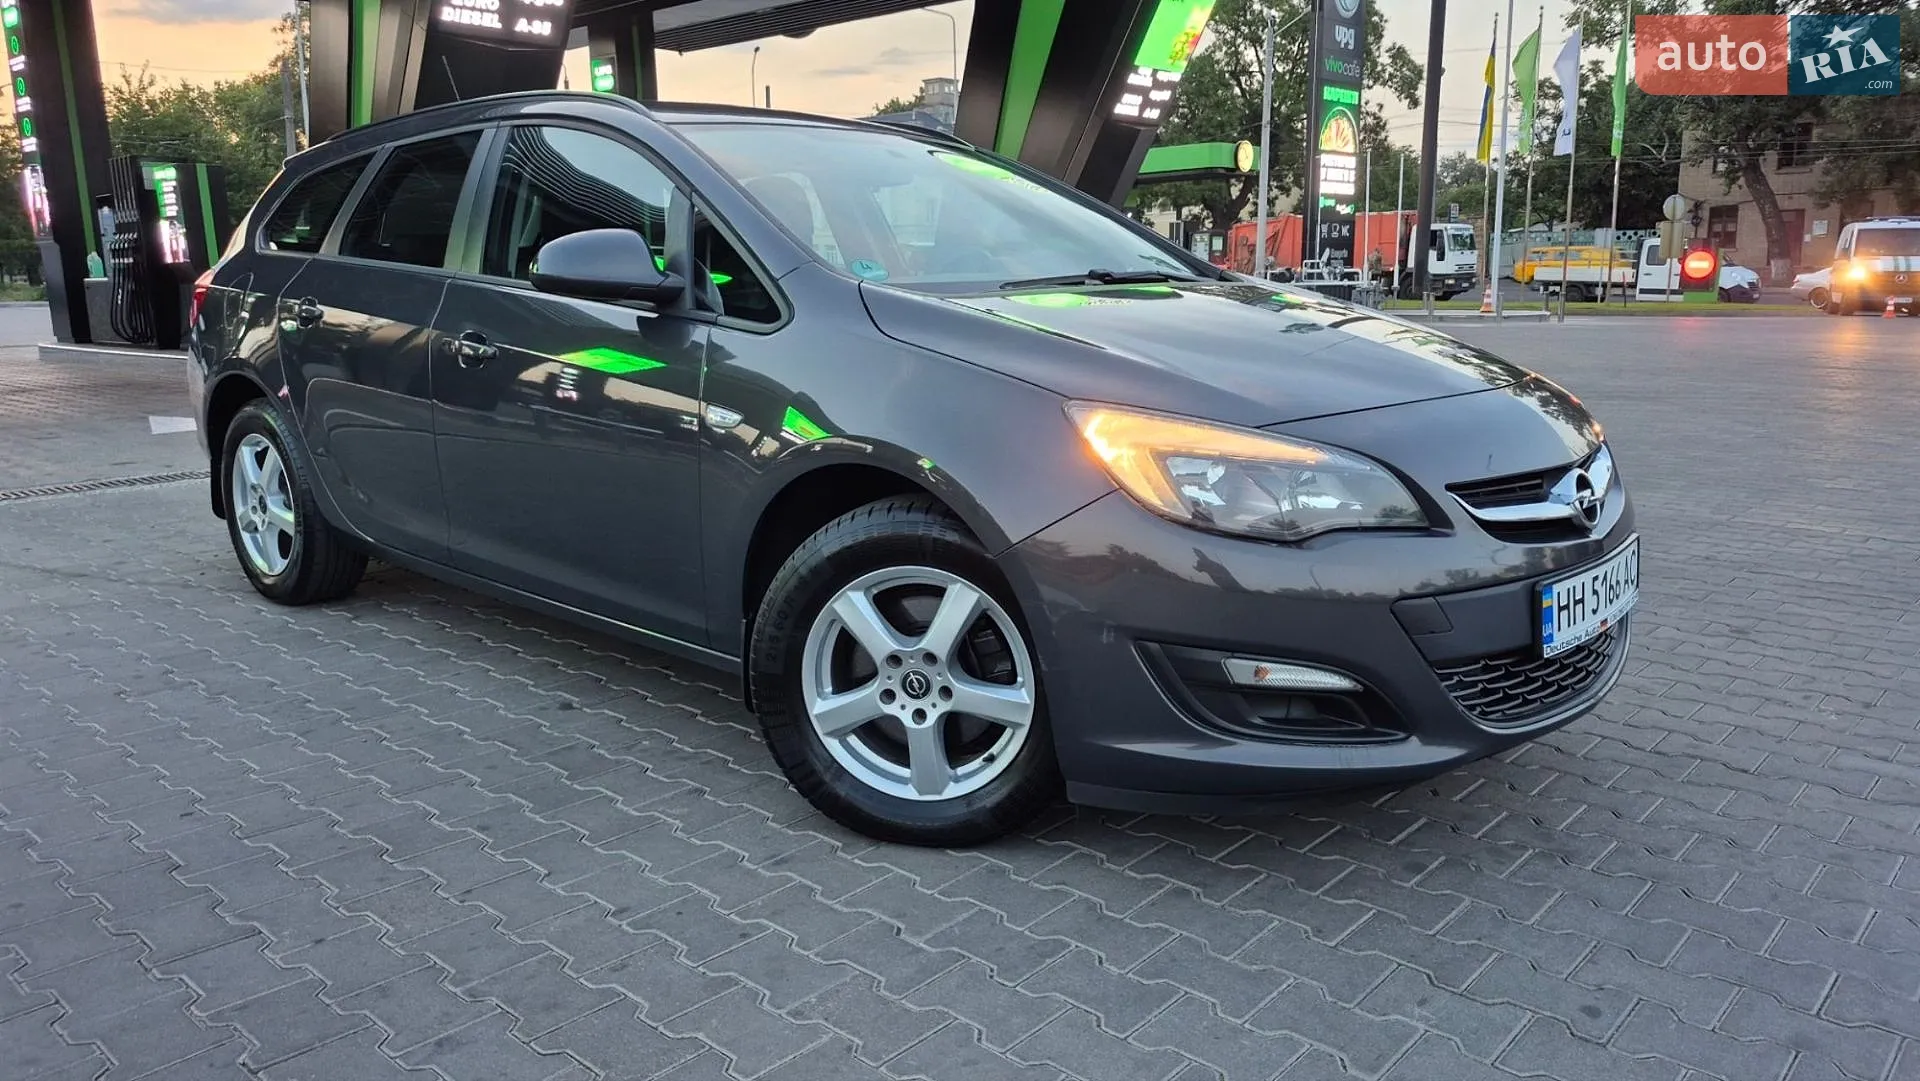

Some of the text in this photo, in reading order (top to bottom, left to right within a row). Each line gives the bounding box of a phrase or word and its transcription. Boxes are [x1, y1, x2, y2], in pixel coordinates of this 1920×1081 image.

[441, 6, 502, 28] DIESEL
[1335, 25, 1355, 50] upg
[1557, 581, 1585, 632] HH
[1591, 561, 1621, 615] 5166
[1623, 548, 1636, 595] AC
[1545, 635, 1583, 655] Deutsche
